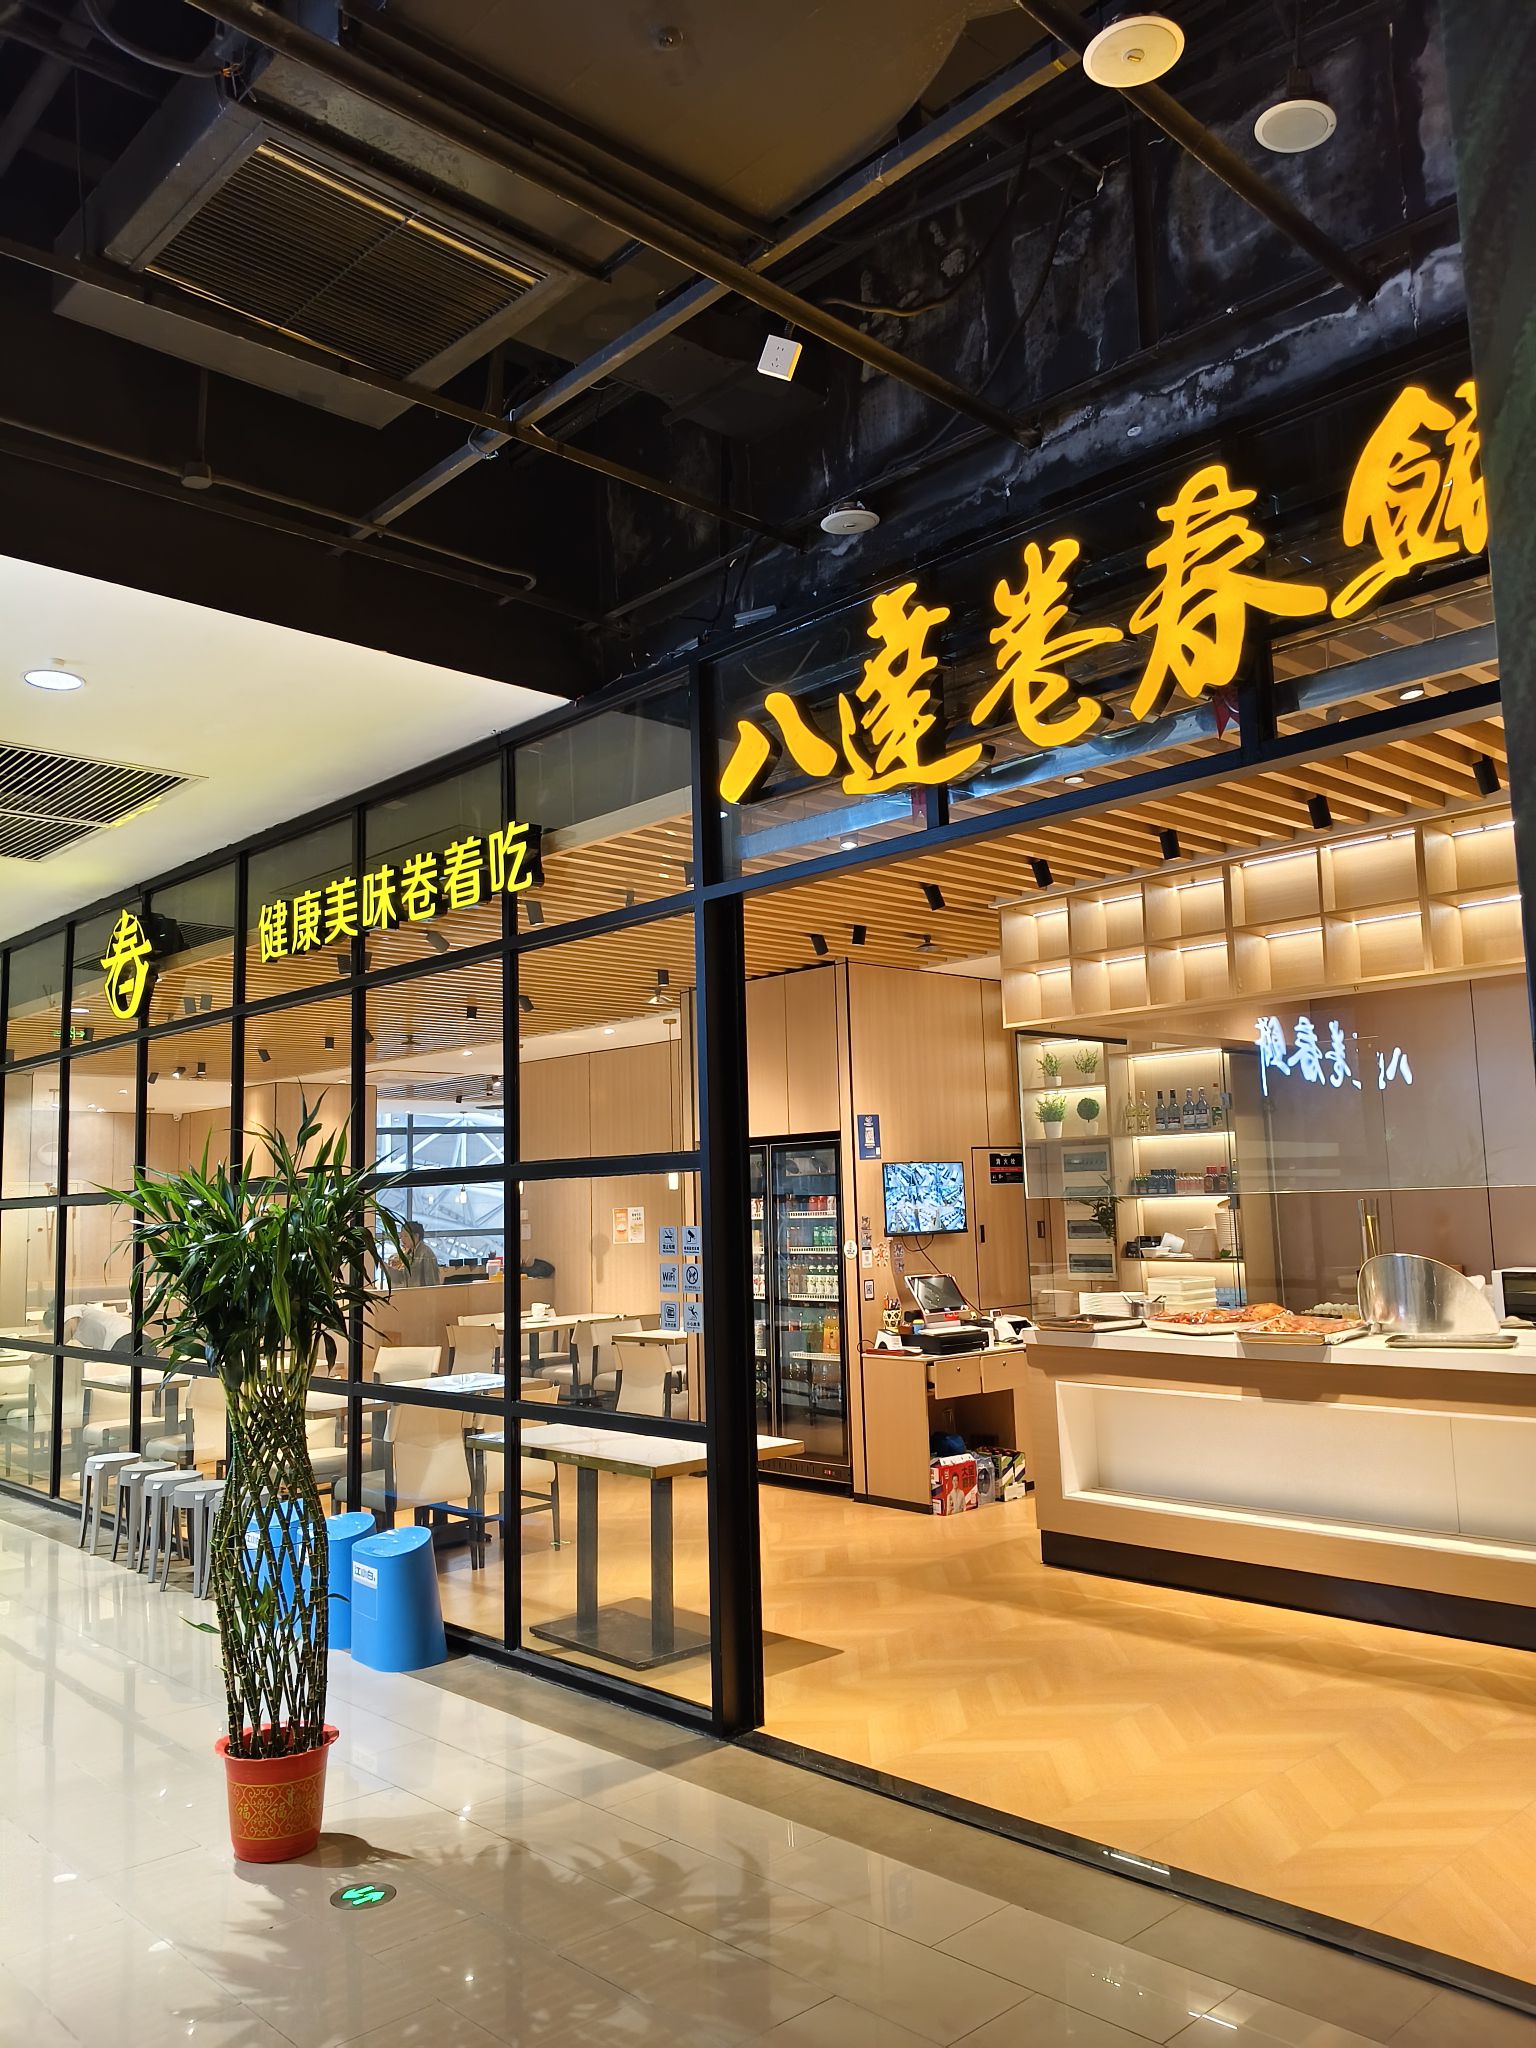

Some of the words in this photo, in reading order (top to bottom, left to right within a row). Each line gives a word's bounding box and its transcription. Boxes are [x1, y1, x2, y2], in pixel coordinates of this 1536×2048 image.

[258, 820, 534, 964] 健康美味卷着吃
[662, 1271, 676, 1282] WiFi
[237, 1803, 251, 1820] 福
[270, 1802, 286, 1820] 福
